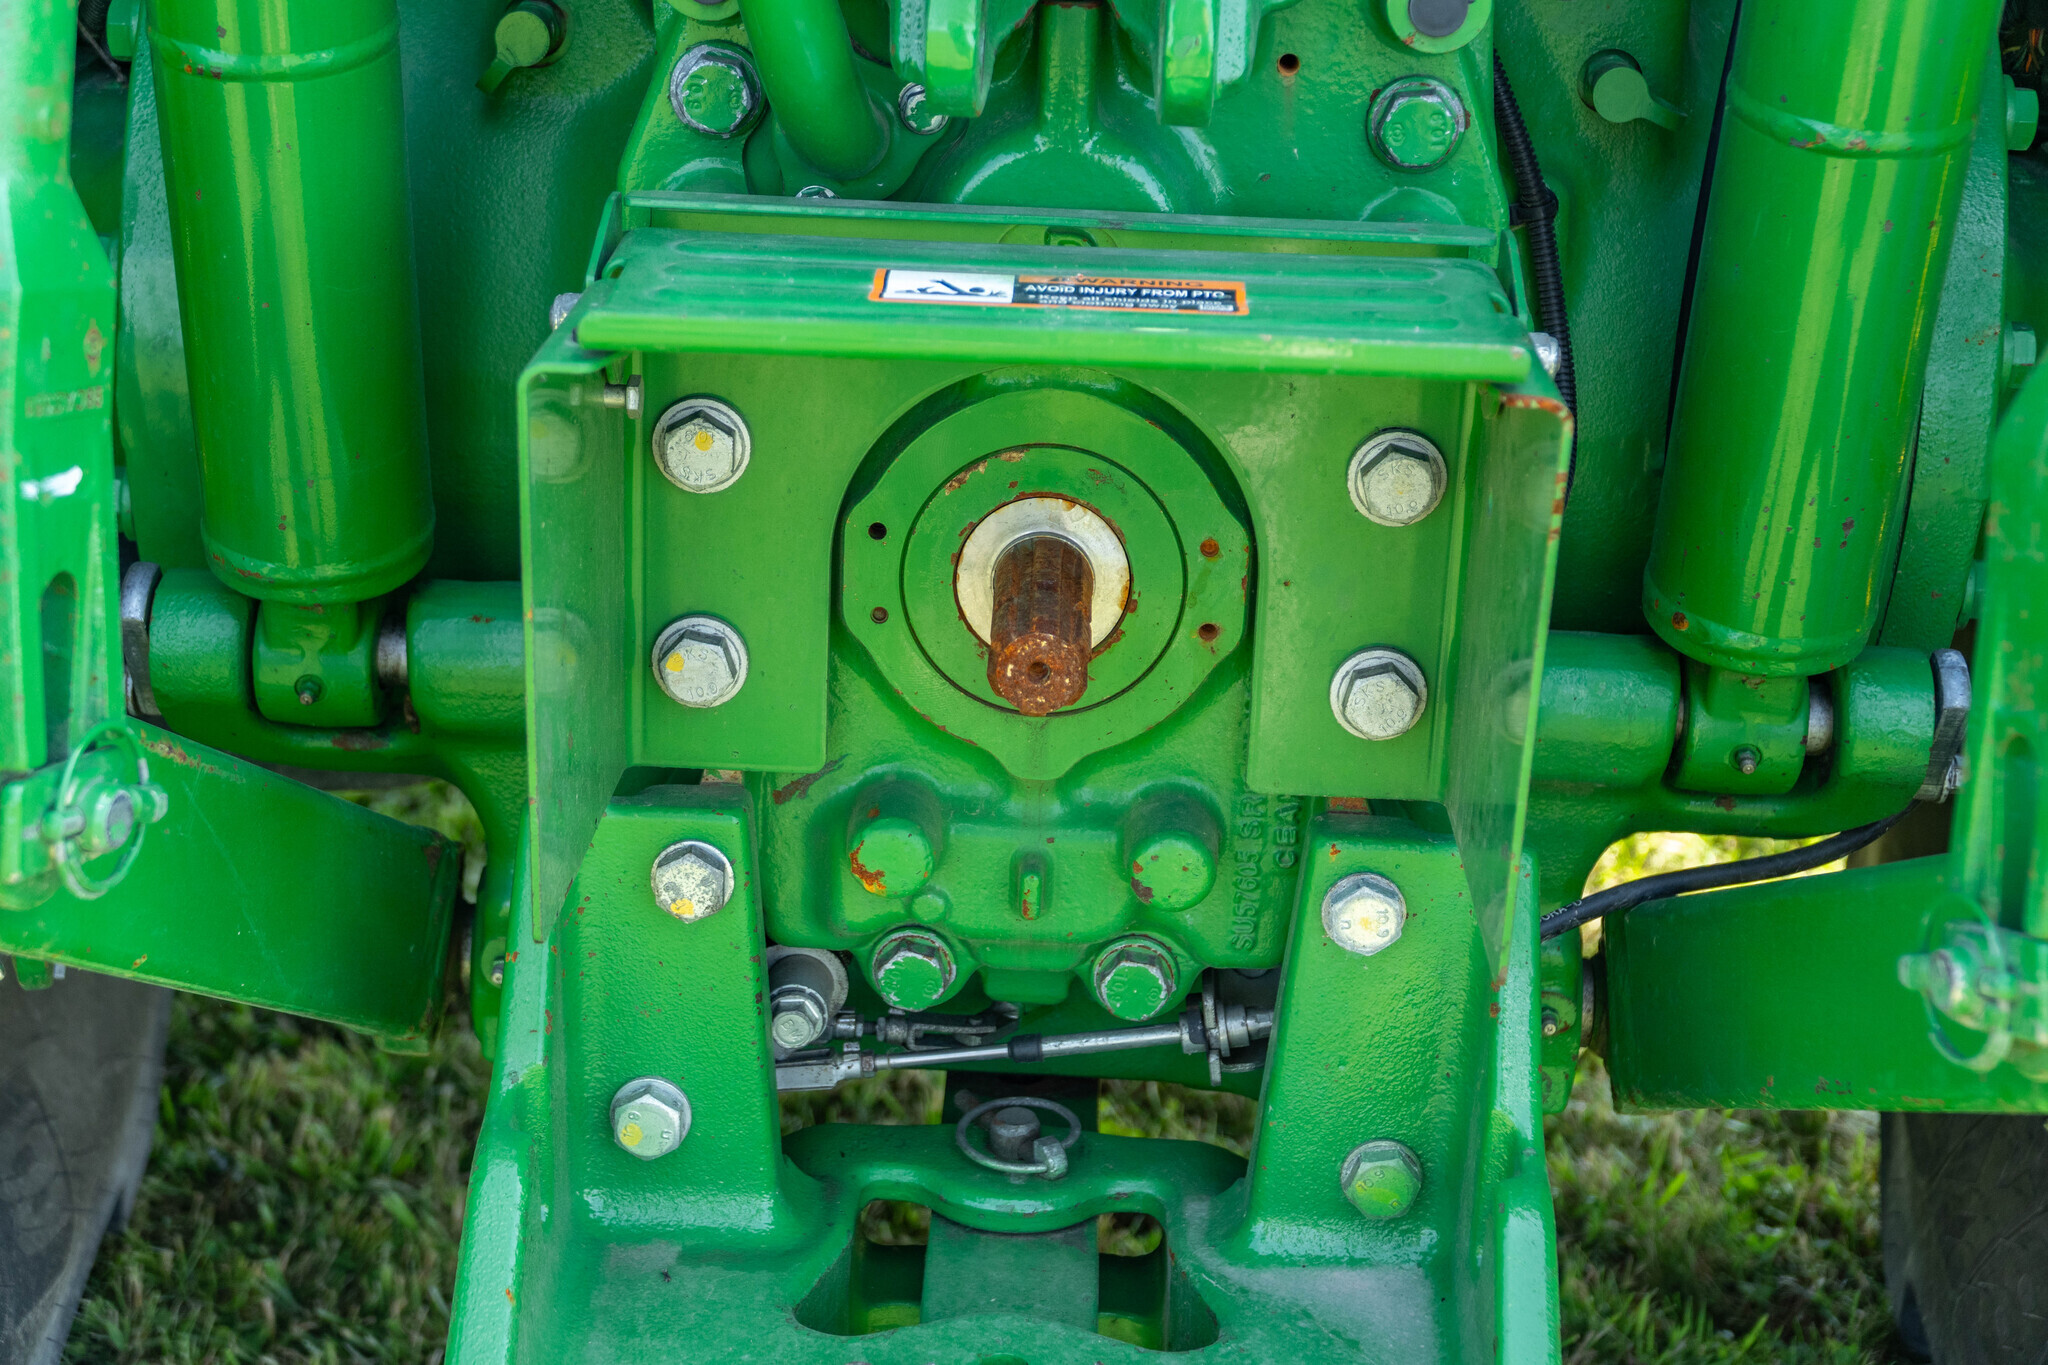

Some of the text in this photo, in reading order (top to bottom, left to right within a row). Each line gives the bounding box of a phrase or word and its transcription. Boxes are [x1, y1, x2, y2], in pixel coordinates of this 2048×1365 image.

[1076, 277, 1204, 288] WARNING
[1025, 284, 1076, 294] AVOID
[1079, 286, 1138, 296] INJURY
[1140, 288, 1188, 299] FROM
